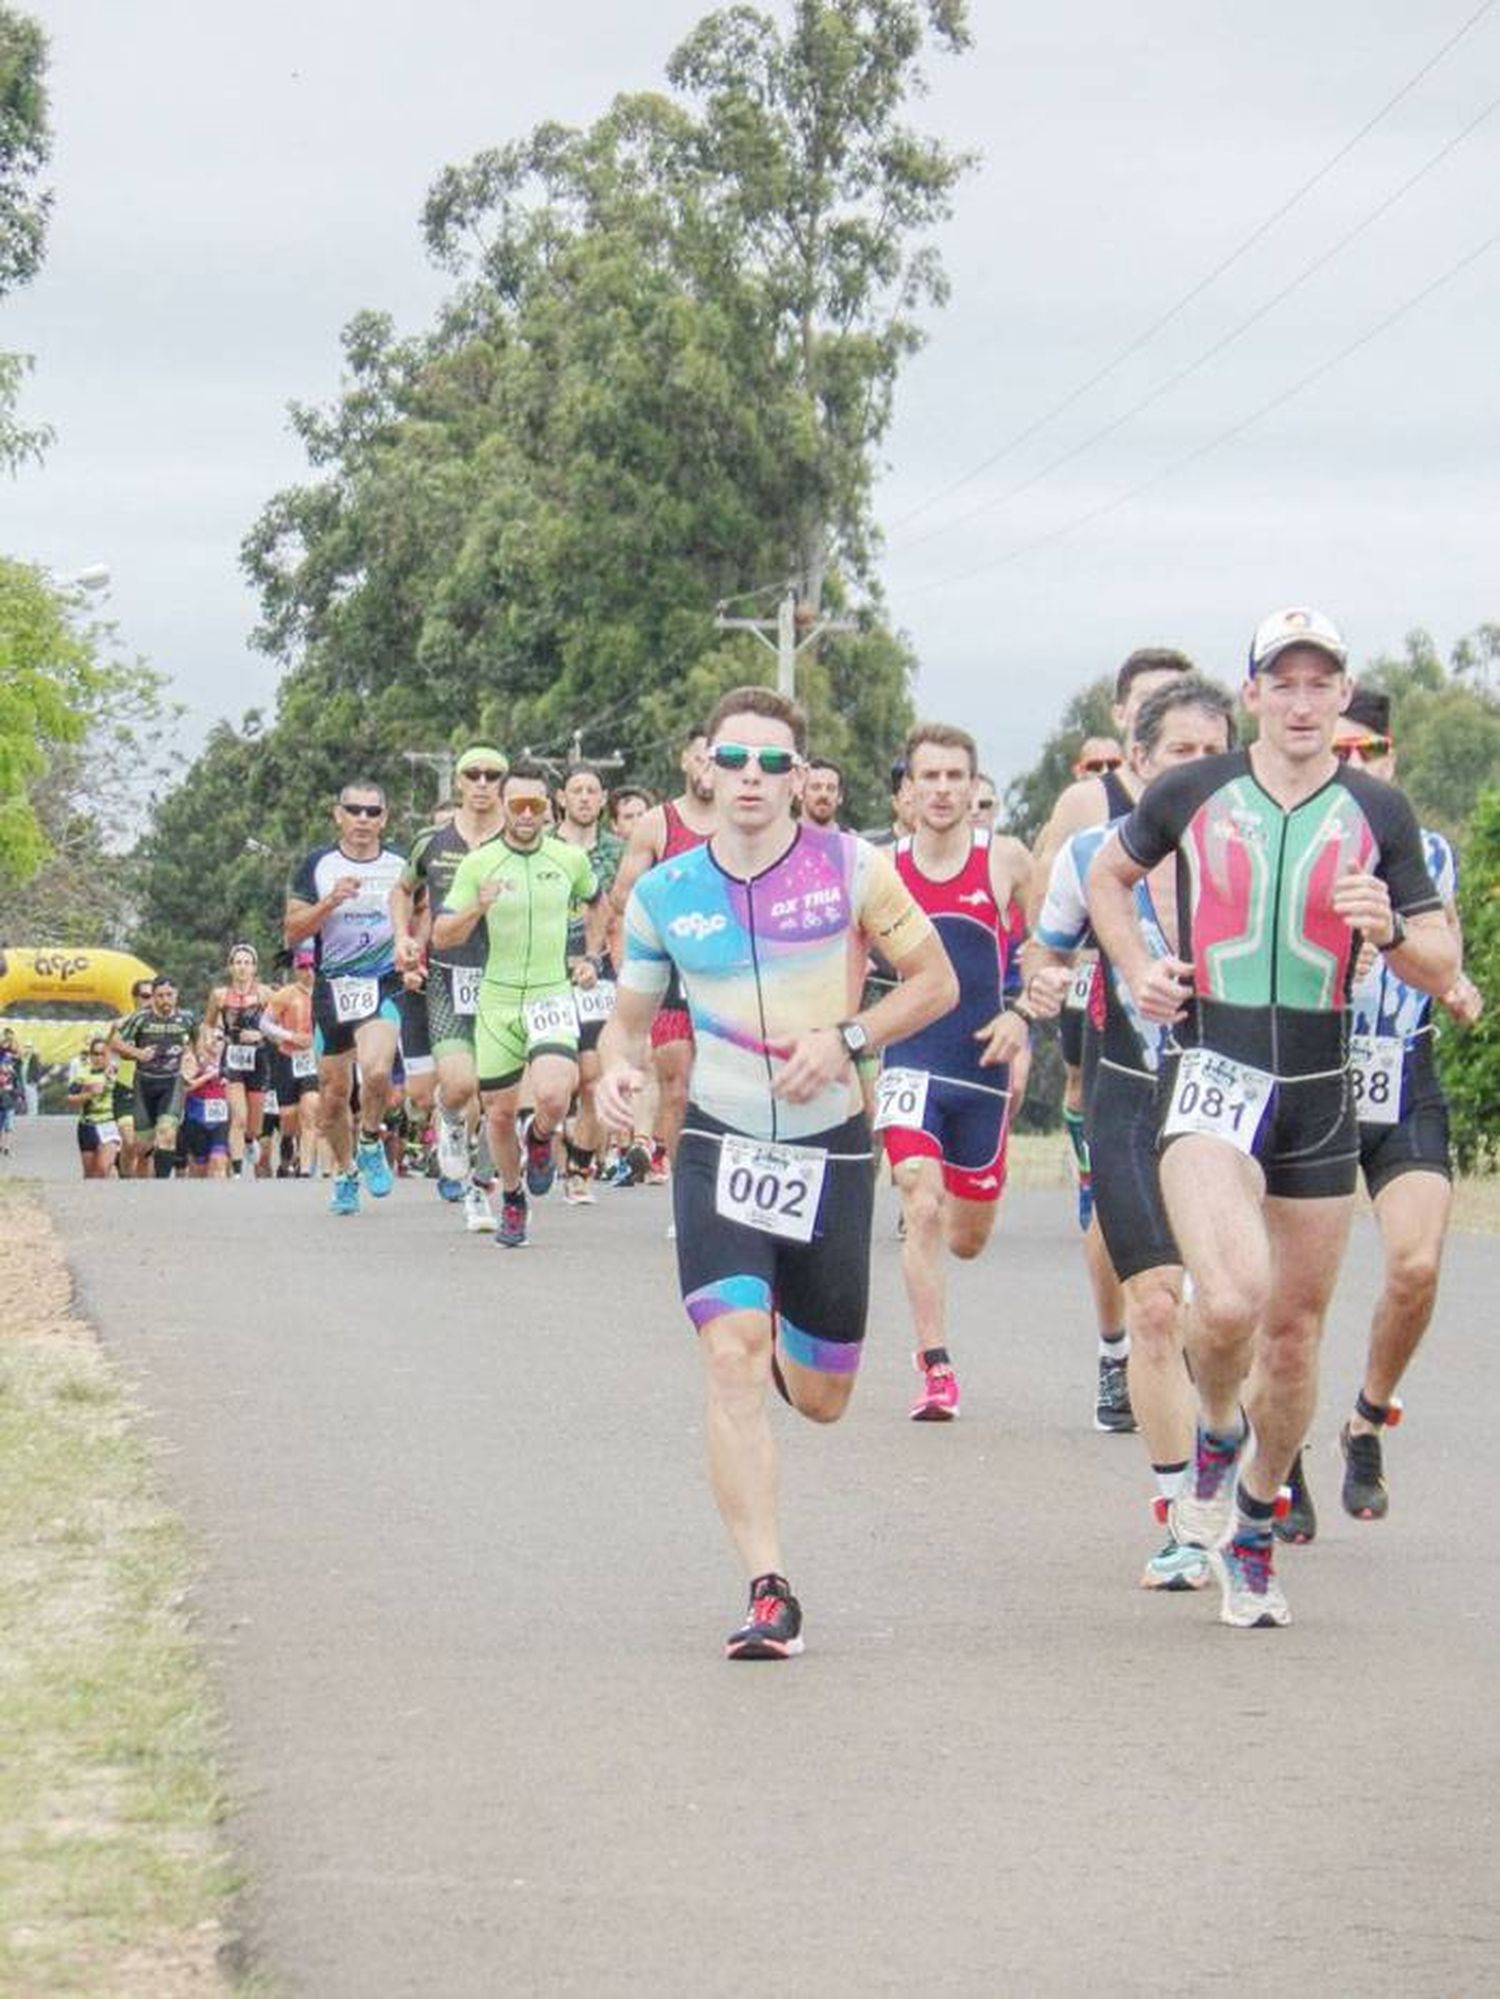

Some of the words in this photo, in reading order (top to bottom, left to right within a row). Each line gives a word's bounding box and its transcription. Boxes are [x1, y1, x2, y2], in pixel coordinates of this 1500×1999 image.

[340, 991, 374, 1012] 078
[1179, 1081, 1245, 1132] 081
[729, 1167, 808, 1219] 002
